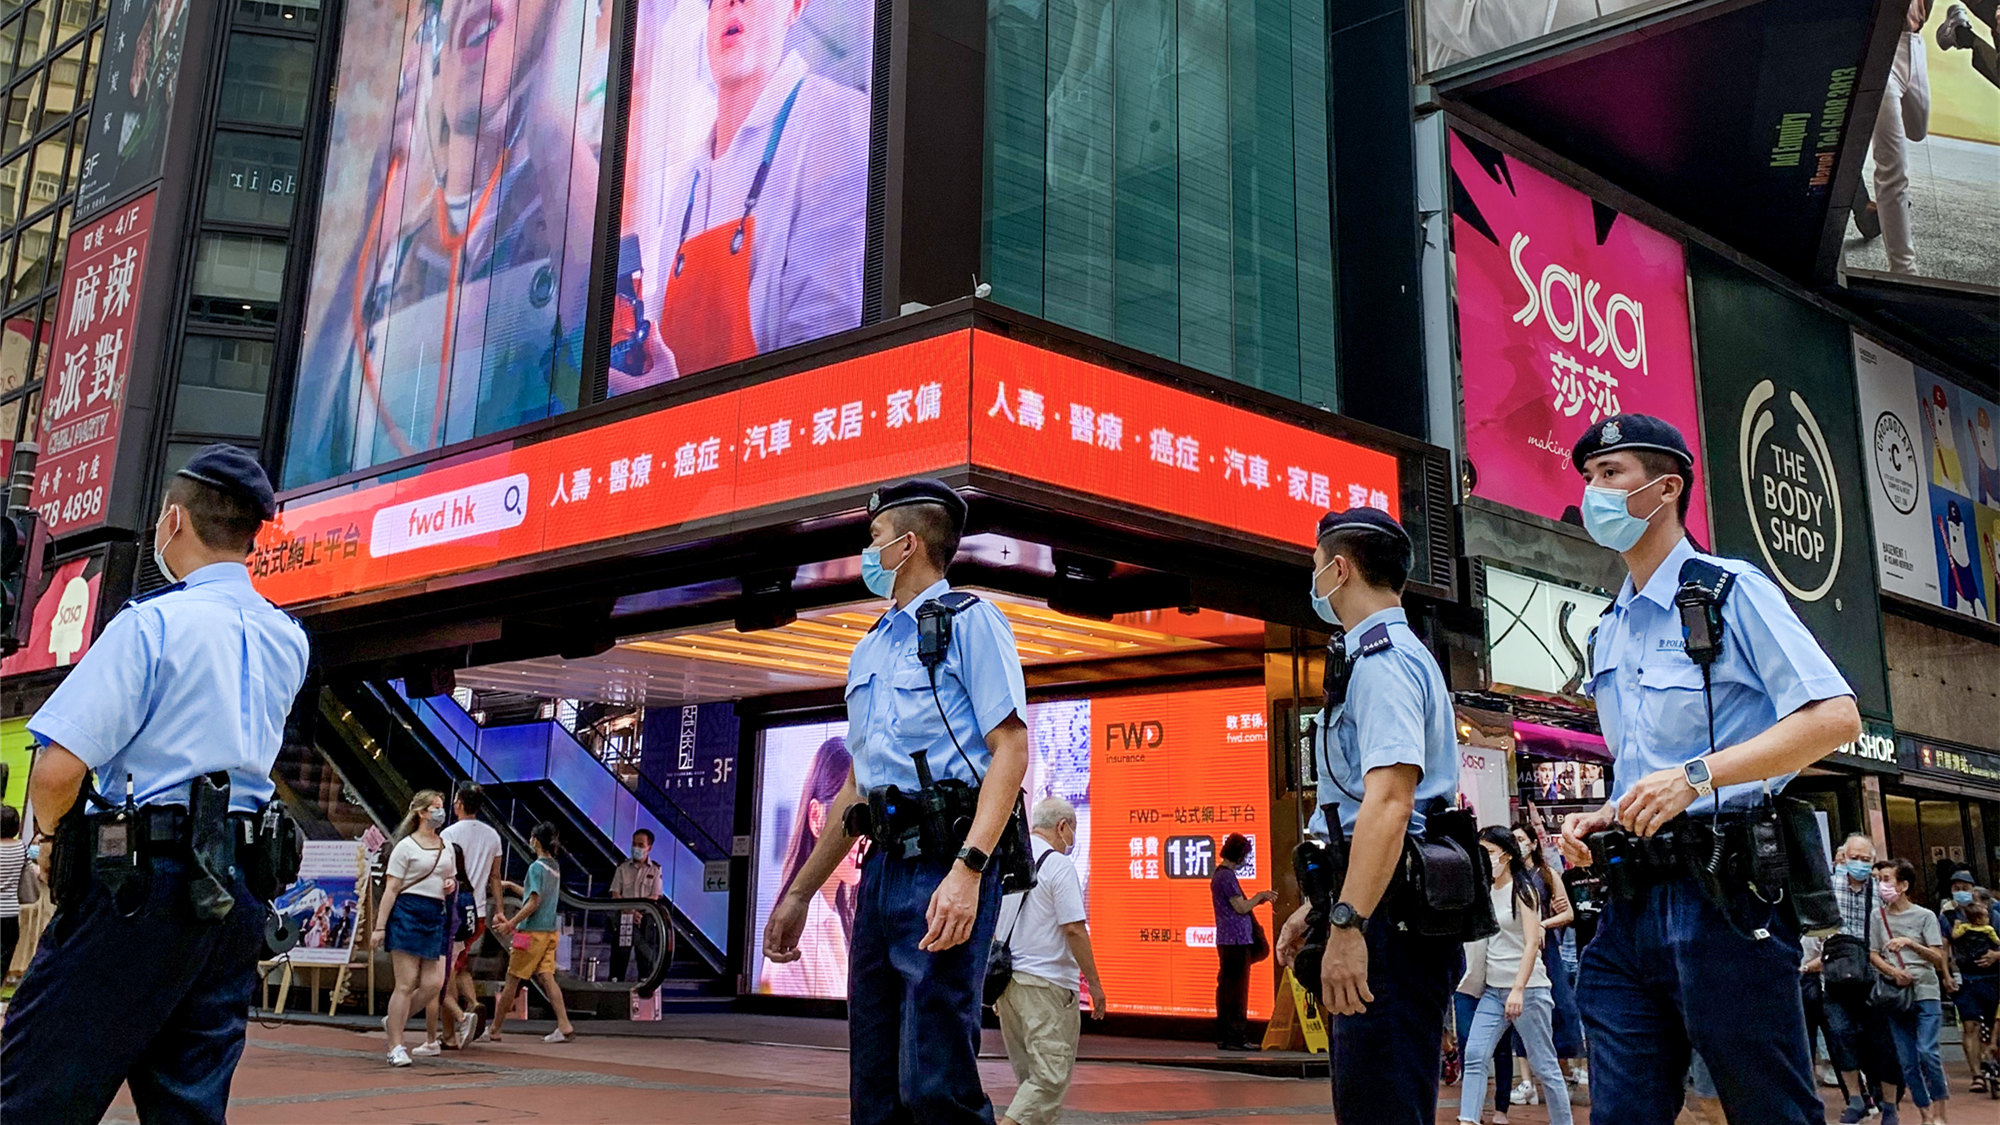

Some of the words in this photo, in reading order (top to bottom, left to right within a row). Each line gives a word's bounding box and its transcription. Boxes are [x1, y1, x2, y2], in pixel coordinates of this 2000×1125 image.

[82, 153, 100, 179] 3F
[66, 246, 138, 339] 麻辣
[54, 328, 123, 421] 派對
[1549, 350, 1621, 424] 莎莎
[1527, 429, 1572, 470] making
[1770, 444, 1808, 484] THE
[61, 485, 103, 524] 4898
[408, 507, 446, 537] fwd
[451, 494, 476, 527] hk
[1762, 474, 1823, 526] BODY
[1770, 517, 1825, 563] SHOP
[1106, 720, 1164, 751] FWD
[711, 757, 734, 784] 3F
[1106, 753, 1146, 764] insurance
[1128, 836, 1159, 858] 保費
[1167, 840, 1212, 878] 1折
[1128, 859, 1160, 880] 低至
[1139, 927, 1182, 943] 投保即上
[1191, 931, 1215, 945] fwd
